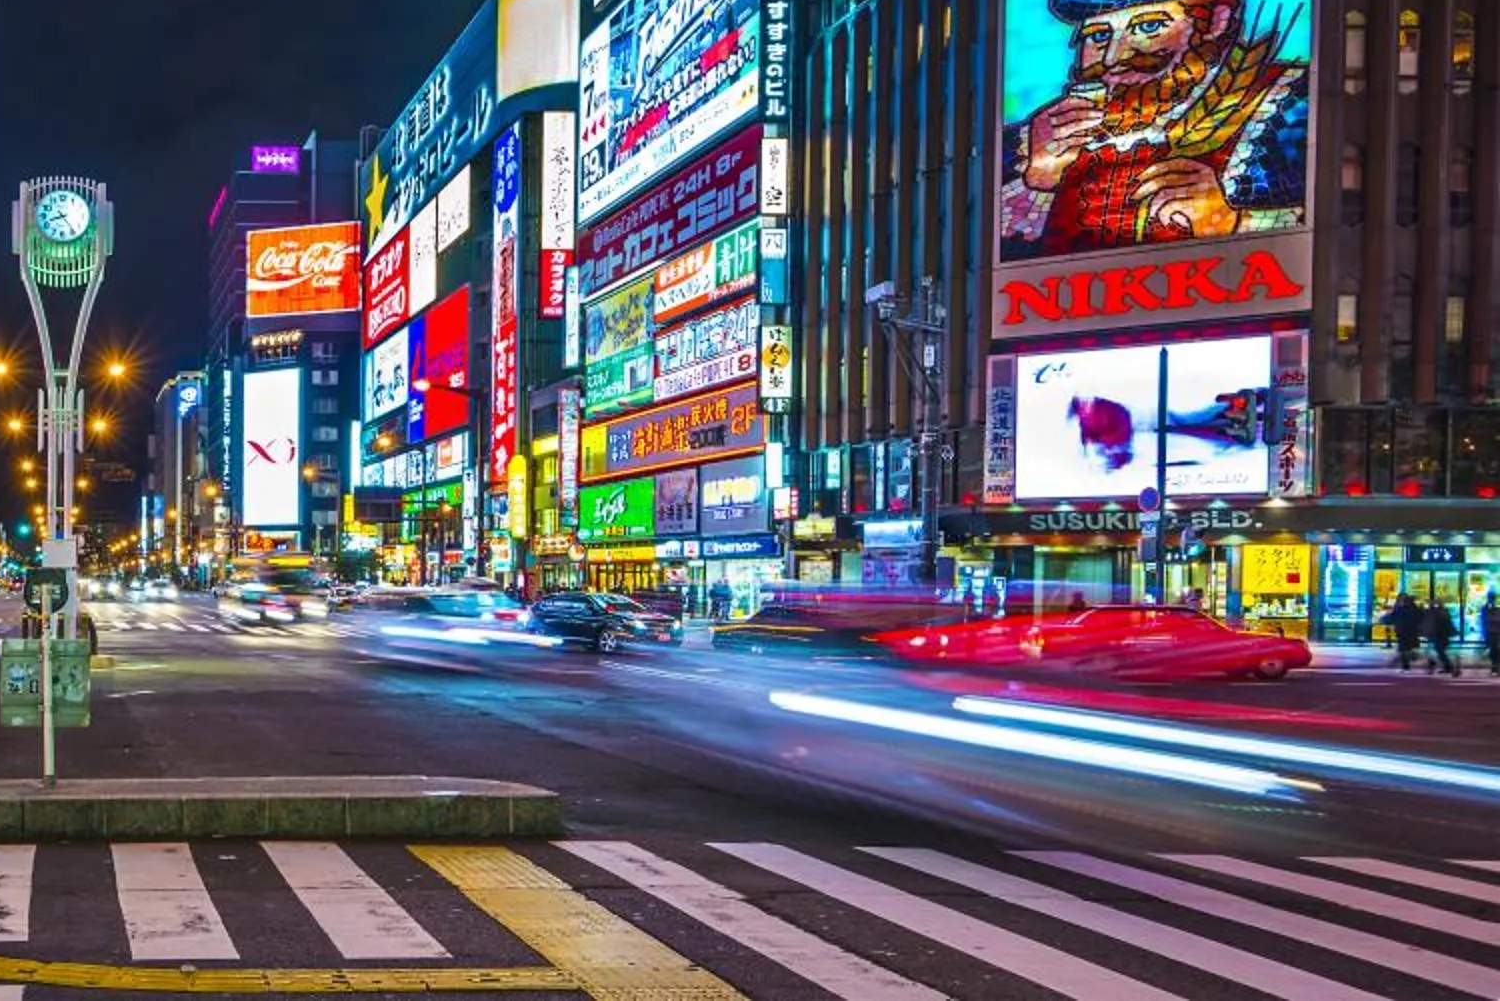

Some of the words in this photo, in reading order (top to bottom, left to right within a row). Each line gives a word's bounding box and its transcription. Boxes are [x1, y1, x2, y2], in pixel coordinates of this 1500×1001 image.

[765, 2, 788, 116] すすきのビル
[673, 164, 711, 204] 24H
[999, 249, 1305, 326] NIKKA
